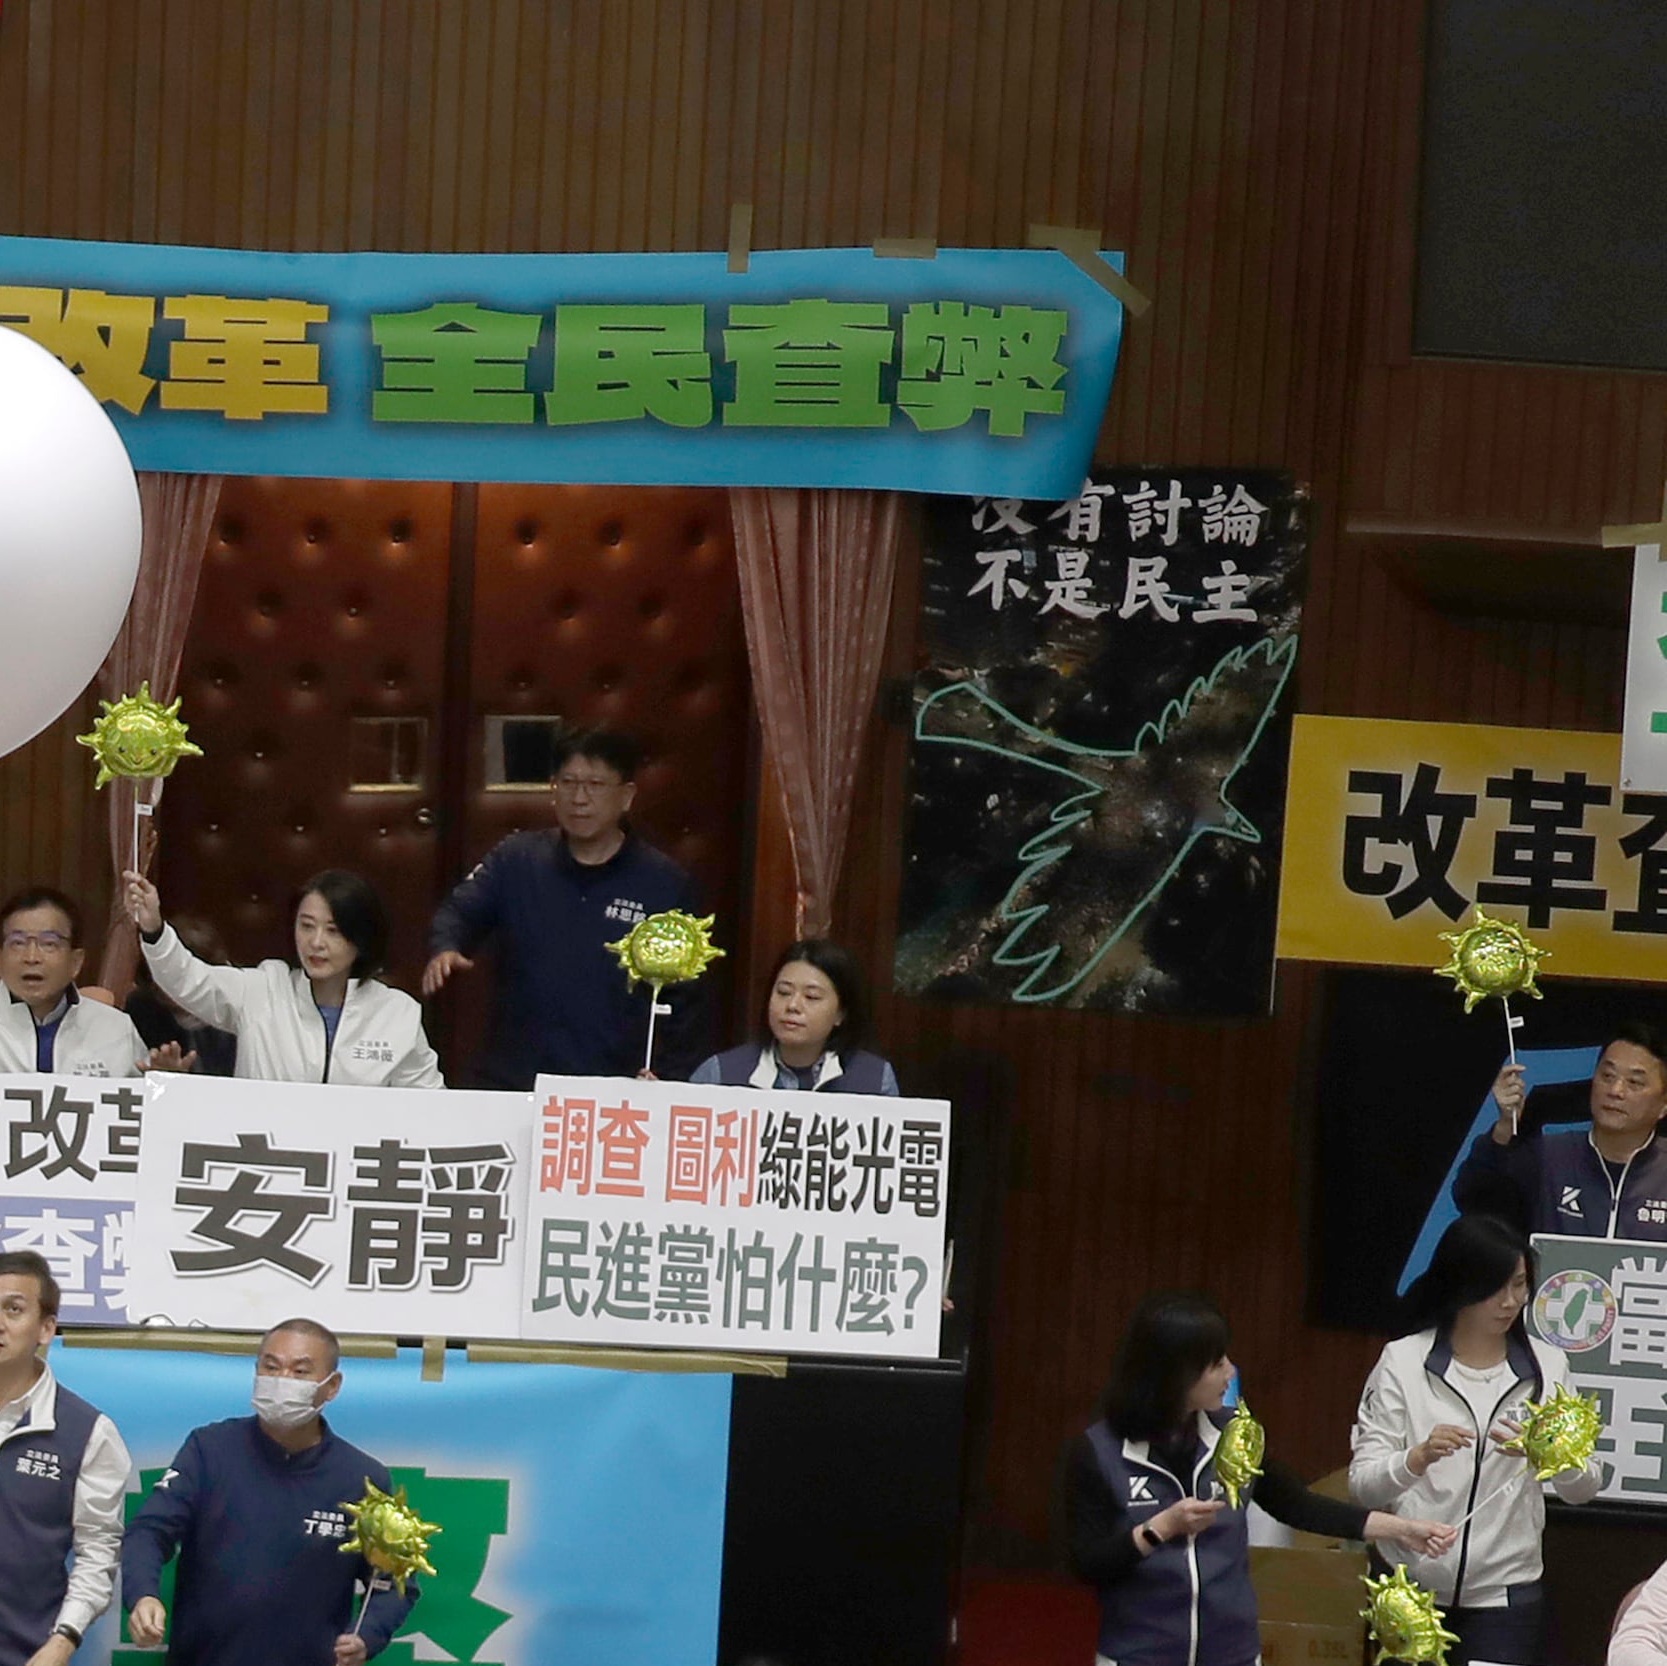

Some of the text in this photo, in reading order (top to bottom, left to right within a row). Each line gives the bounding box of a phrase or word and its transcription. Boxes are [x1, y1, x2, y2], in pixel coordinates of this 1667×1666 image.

[371, 298, 1069, 437] 全民查弊
[967, 549, 1273, 624] 不是民主
[169, 1132, 513, 1290] 安靜
[540, 1096, 943, 1218] 調查 圖利綠能光電
[531, 1218, 929, 1338] 民進黨怕什麼?
